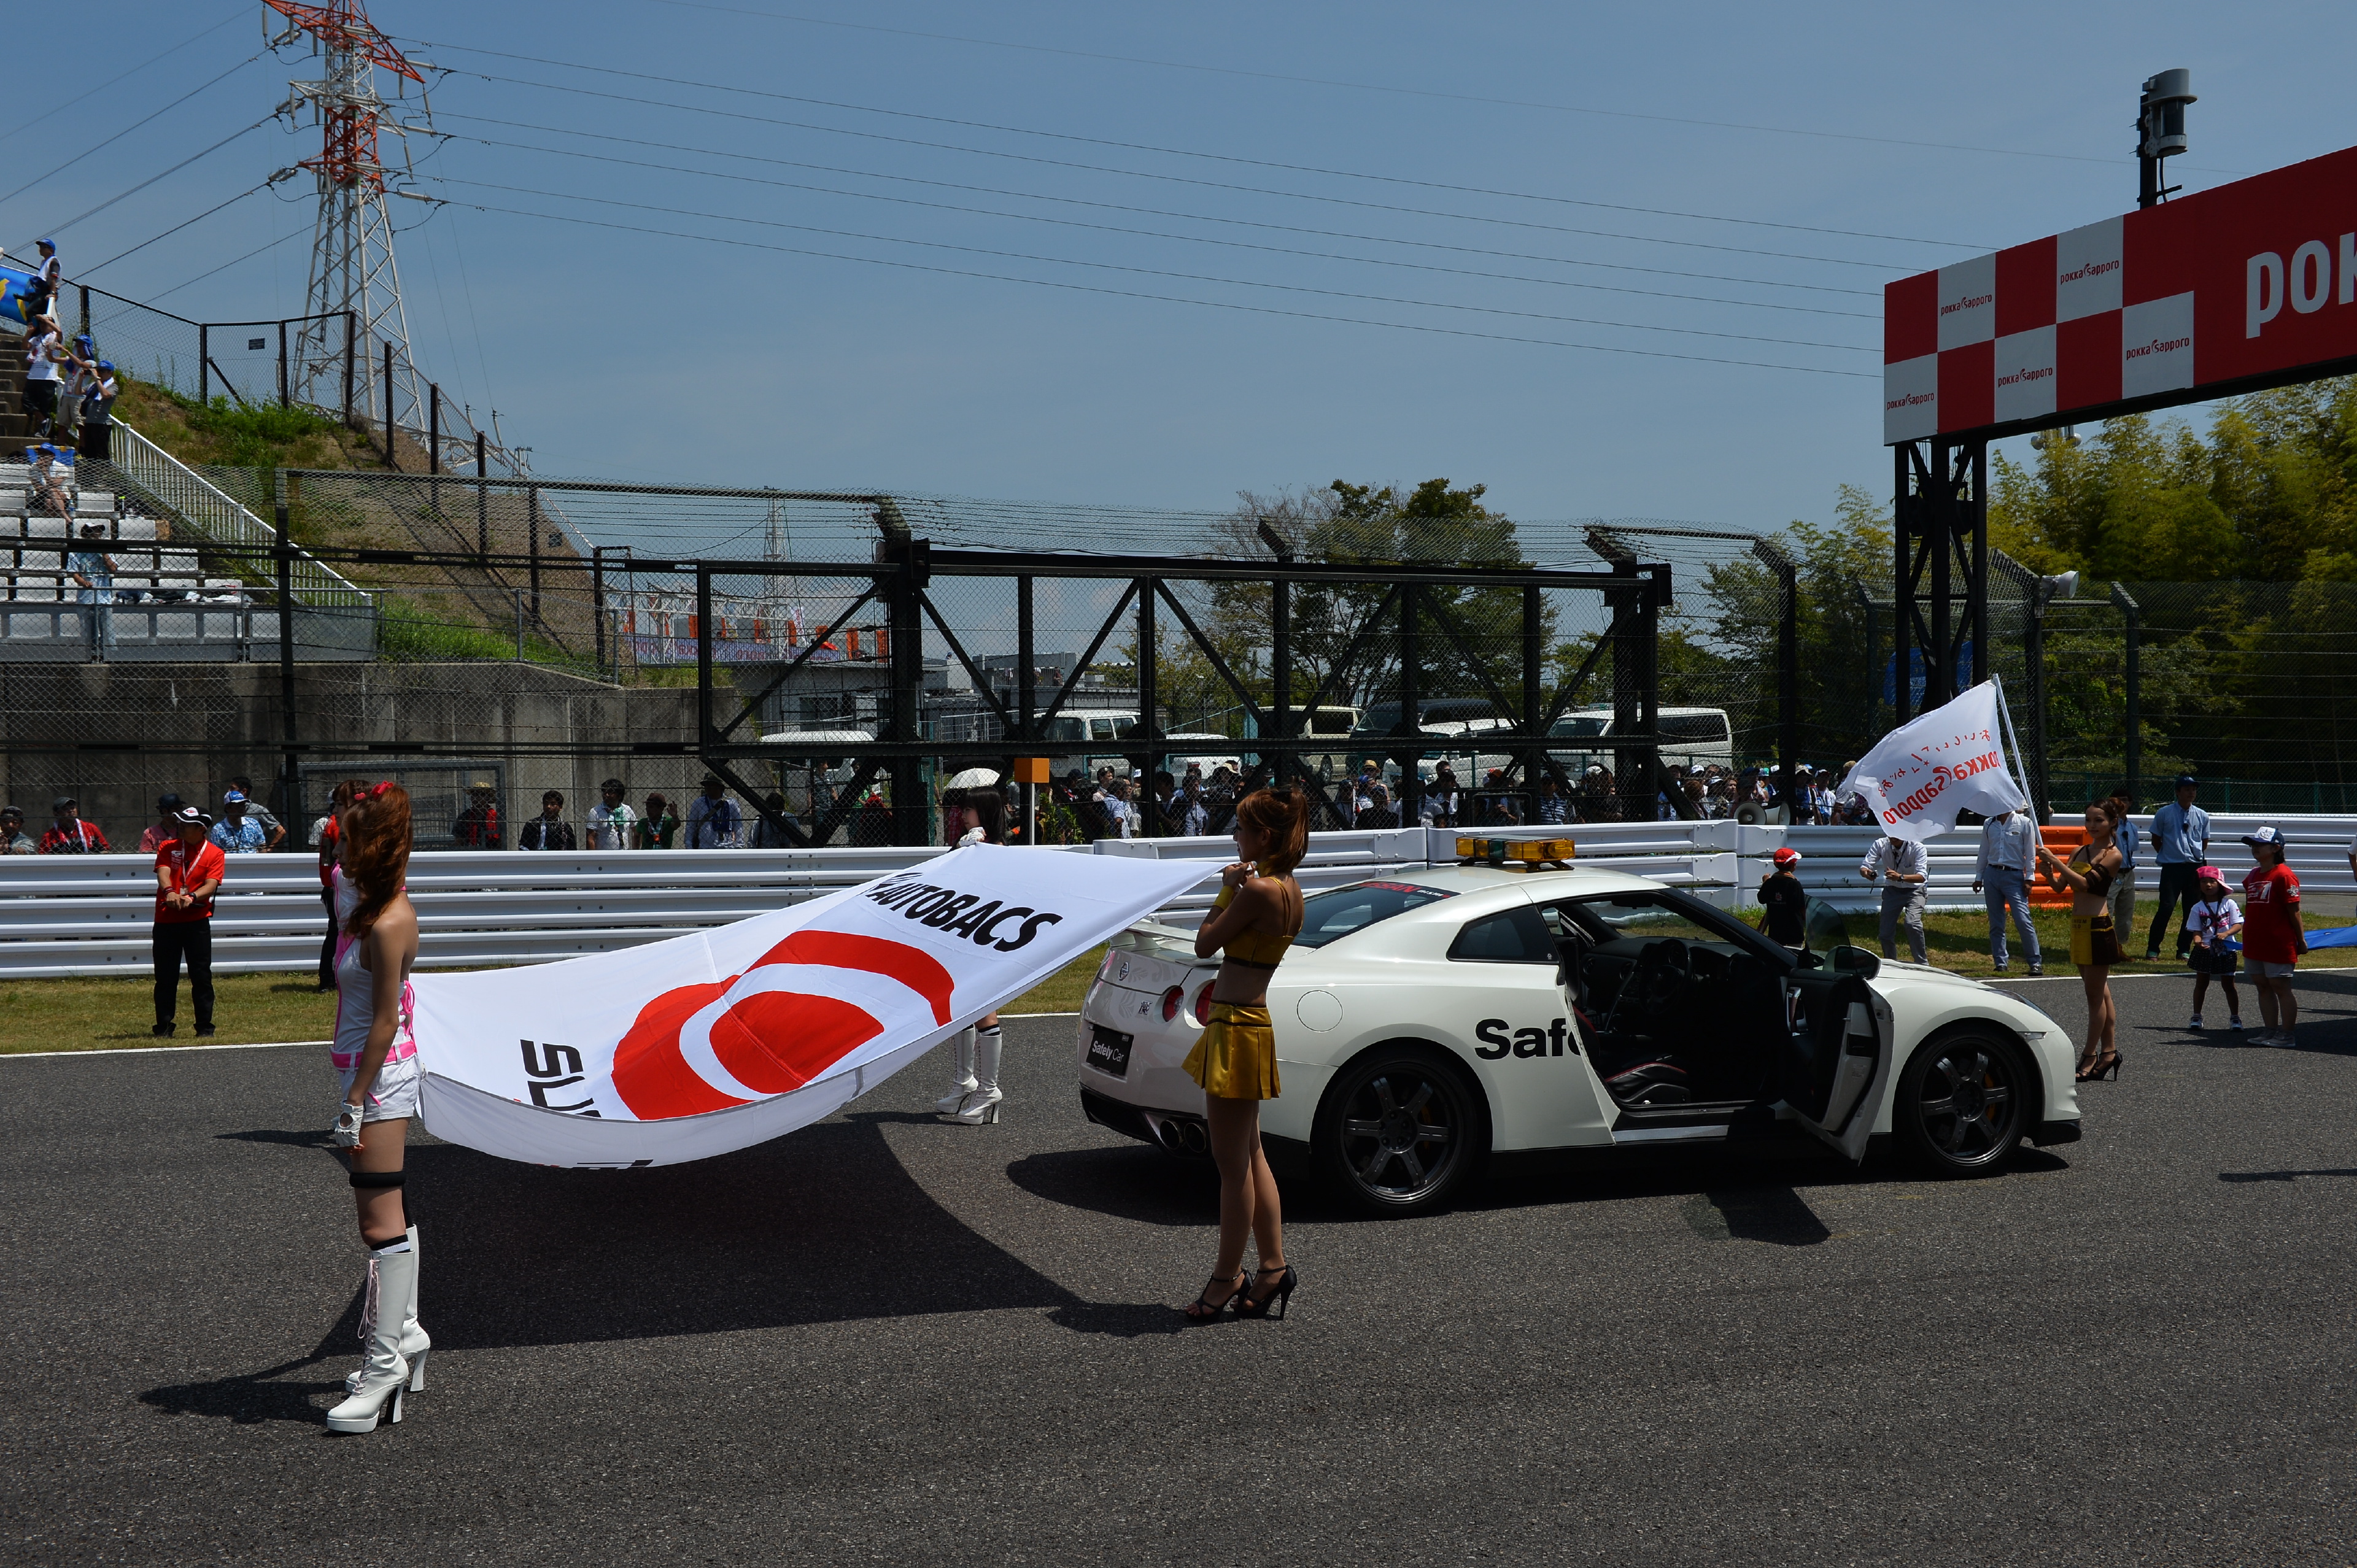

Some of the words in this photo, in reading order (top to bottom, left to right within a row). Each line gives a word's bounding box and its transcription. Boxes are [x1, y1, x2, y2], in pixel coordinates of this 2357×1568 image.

[865, 872, 1063, 952] AUTOBACS
[1092, 1040, 1113, 1060] Safety
[1112, 1048, 1124, 1063] Car
